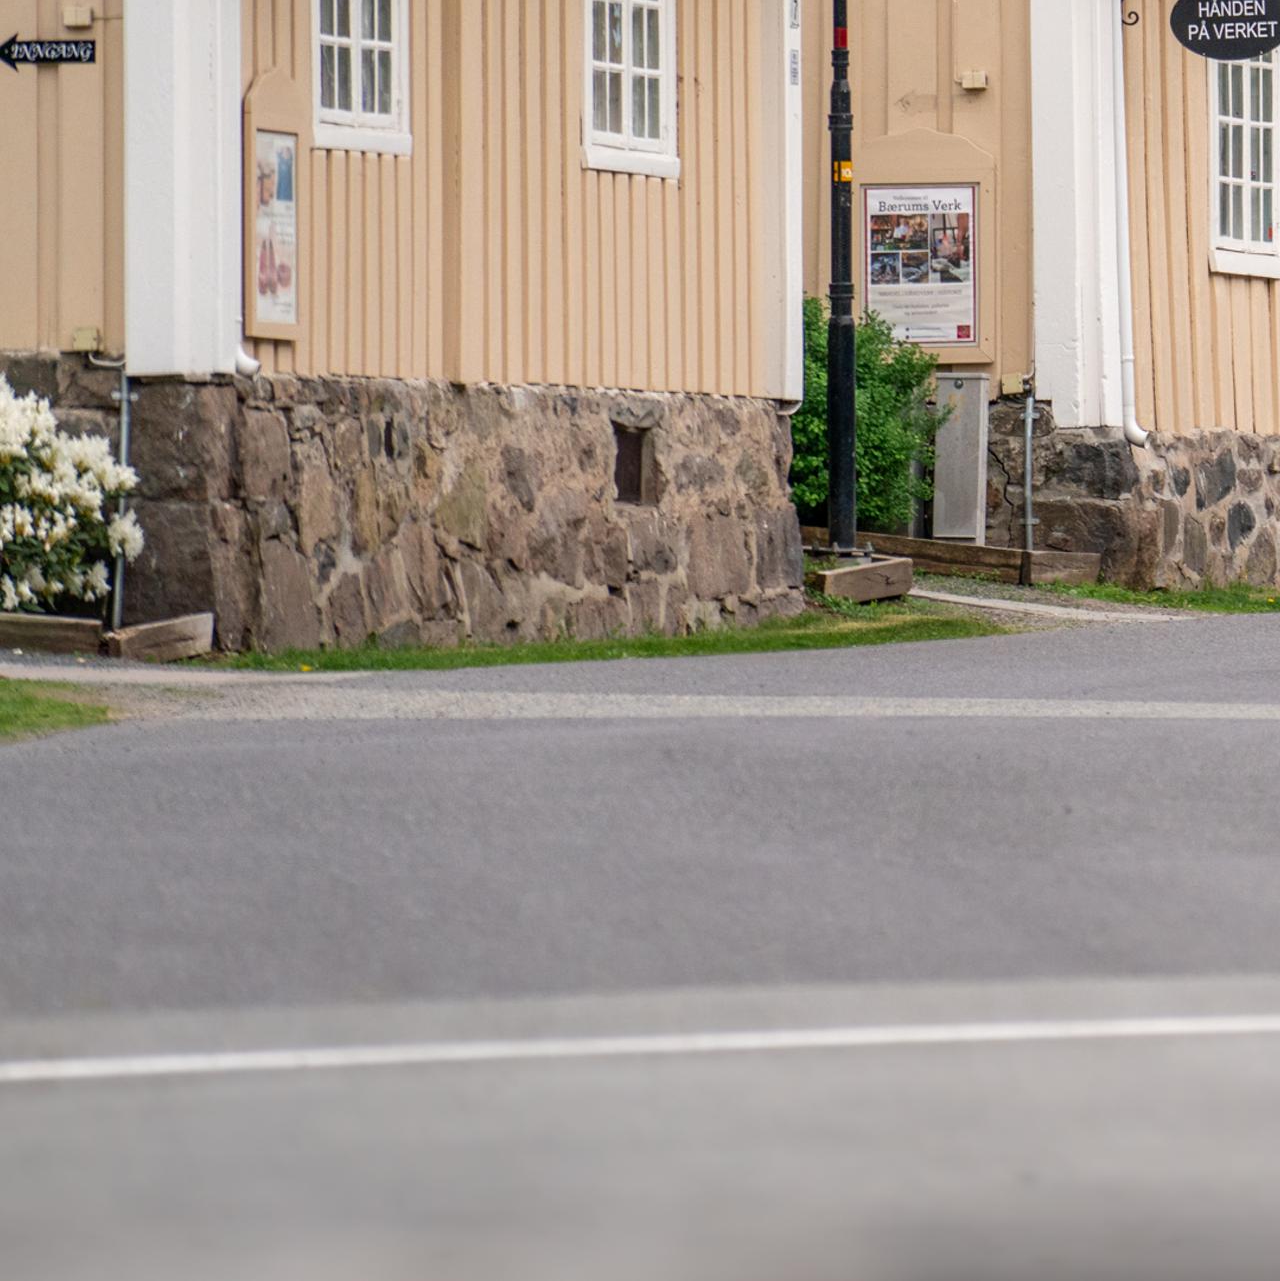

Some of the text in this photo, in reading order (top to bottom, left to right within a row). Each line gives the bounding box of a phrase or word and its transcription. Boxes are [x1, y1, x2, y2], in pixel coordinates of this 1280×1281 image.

[1188, 20, 1278, 41] PÅ VERKET
[11, 42, 93, 62] INNGANG
[878, 199, 962, 213] Bærums Verk
